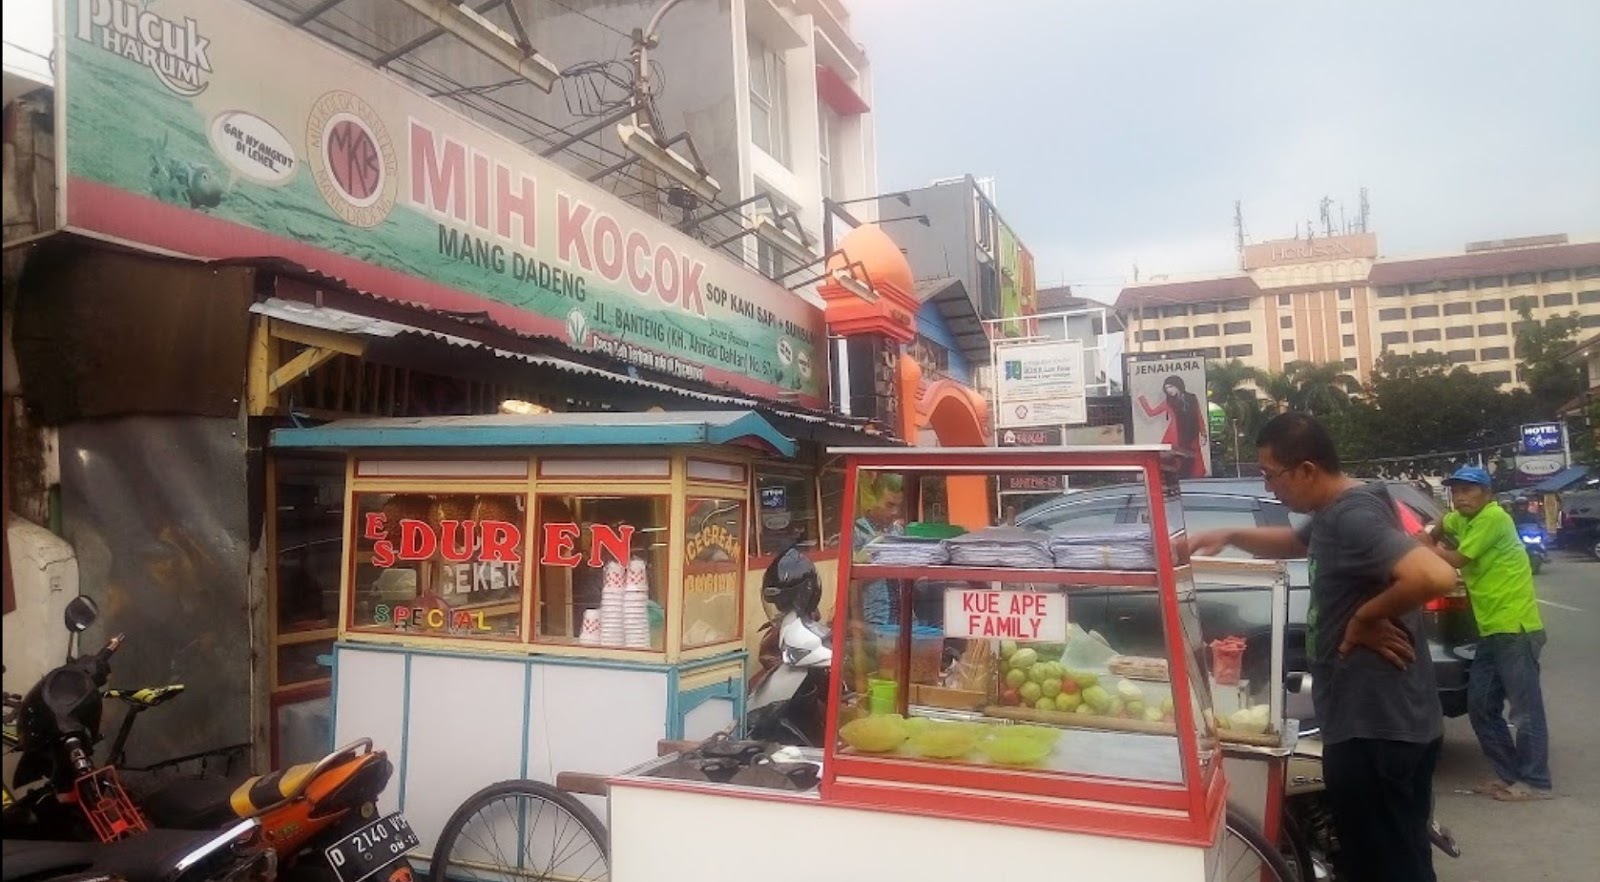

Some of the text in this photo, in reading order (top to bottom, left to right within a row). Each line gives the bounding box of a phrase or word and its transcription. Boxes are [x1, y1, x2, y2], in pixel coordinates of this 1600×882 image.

[102, 26, 206, 92] HARUM
[223, 123, 294, 169] GAK NYANGKUT
[236, 141, 245, 155] DI
[408, 116, 708, 318] MIH KOCOK
[438, 223, 586, 302] MANG DADENG
[705, 283, 727, 307] SOP
[730, 293, 755, 319] KAKI
[615, 308, 665, 343] BANTENG
[1524, 425, 1559, 435] HOTEL
[374, 604, 493, 632] SPECIAL
[962, 591, 1048, 616] KUE APE
[968, 615, 1041, 638] FAMILY
[330, 849, 346, 867] D
[352, 823, 389, 853] 2140
